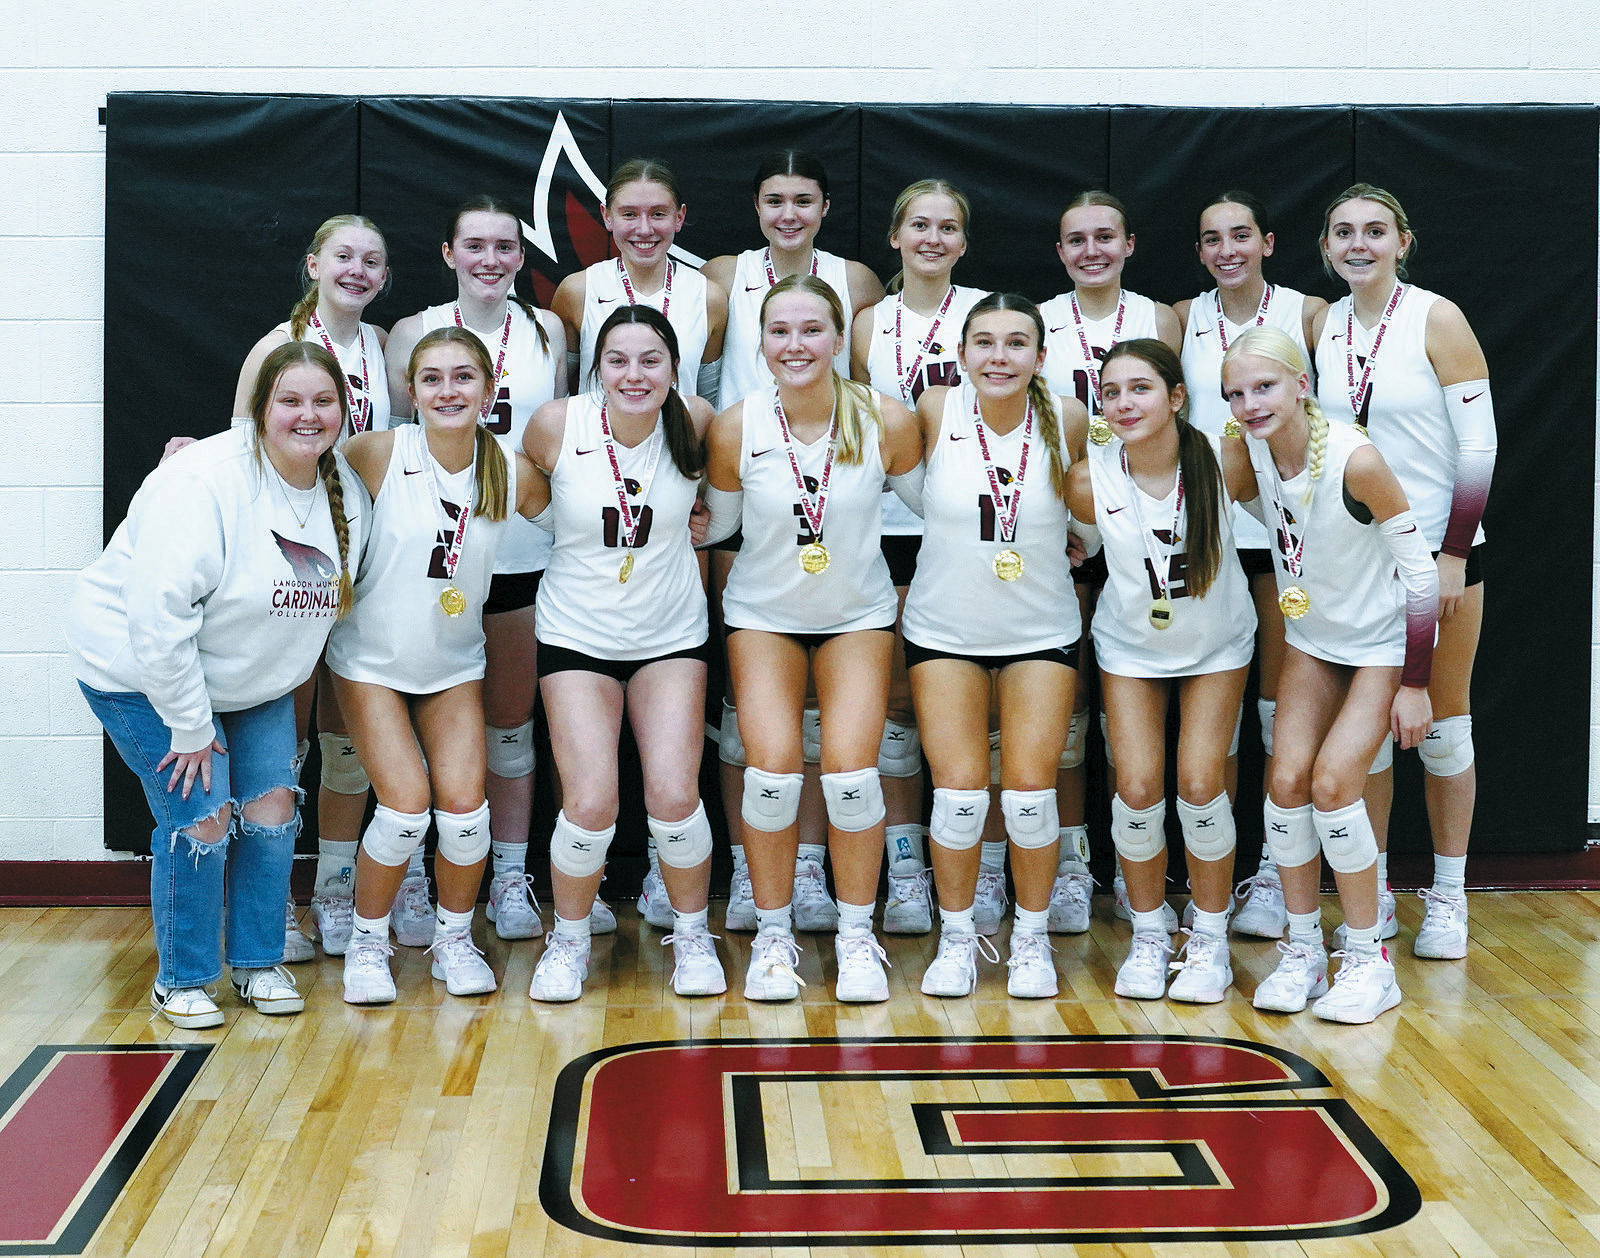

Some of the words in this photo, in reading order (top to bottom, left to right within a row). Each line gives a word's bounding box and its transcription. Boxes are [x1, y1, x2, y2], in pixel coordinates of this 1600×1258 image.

[922, 319, 941, 350] CHAMPION
[1078, 331, 1092, 361] CHAMPION
[1370, 323, 1387, 359] CHAMPION
[905, 354, 924, 388] CHAMPION
[1347, 353, 1355, 387] CHAMPION
[1355, 366, 1372, 403] CHAMPION
[775, 406, 790, 443] CHAMPION
[976, 424, 991, 461] CHAMPION
[606, 444, 622, 482] CHAMPION
[788, 452, 804, 489] CHAMPION
[1017, 442, 1030, 482] CHAMPION
[987, 470, 1004, 508] CHAMPION
[455, 506, 470, 545] CHAMPION
[617, 490, 633, 528] CHAMPION
[793, 503, 824, 546] 3
[427, 529, 456, 580] 2
[273, 579, 312, 588] LANGDON
[316, 580, 339, 588] MUNIC
[1144, 552, 1194, 600] 15
[272, 588, 340, 610] CARDINAL
